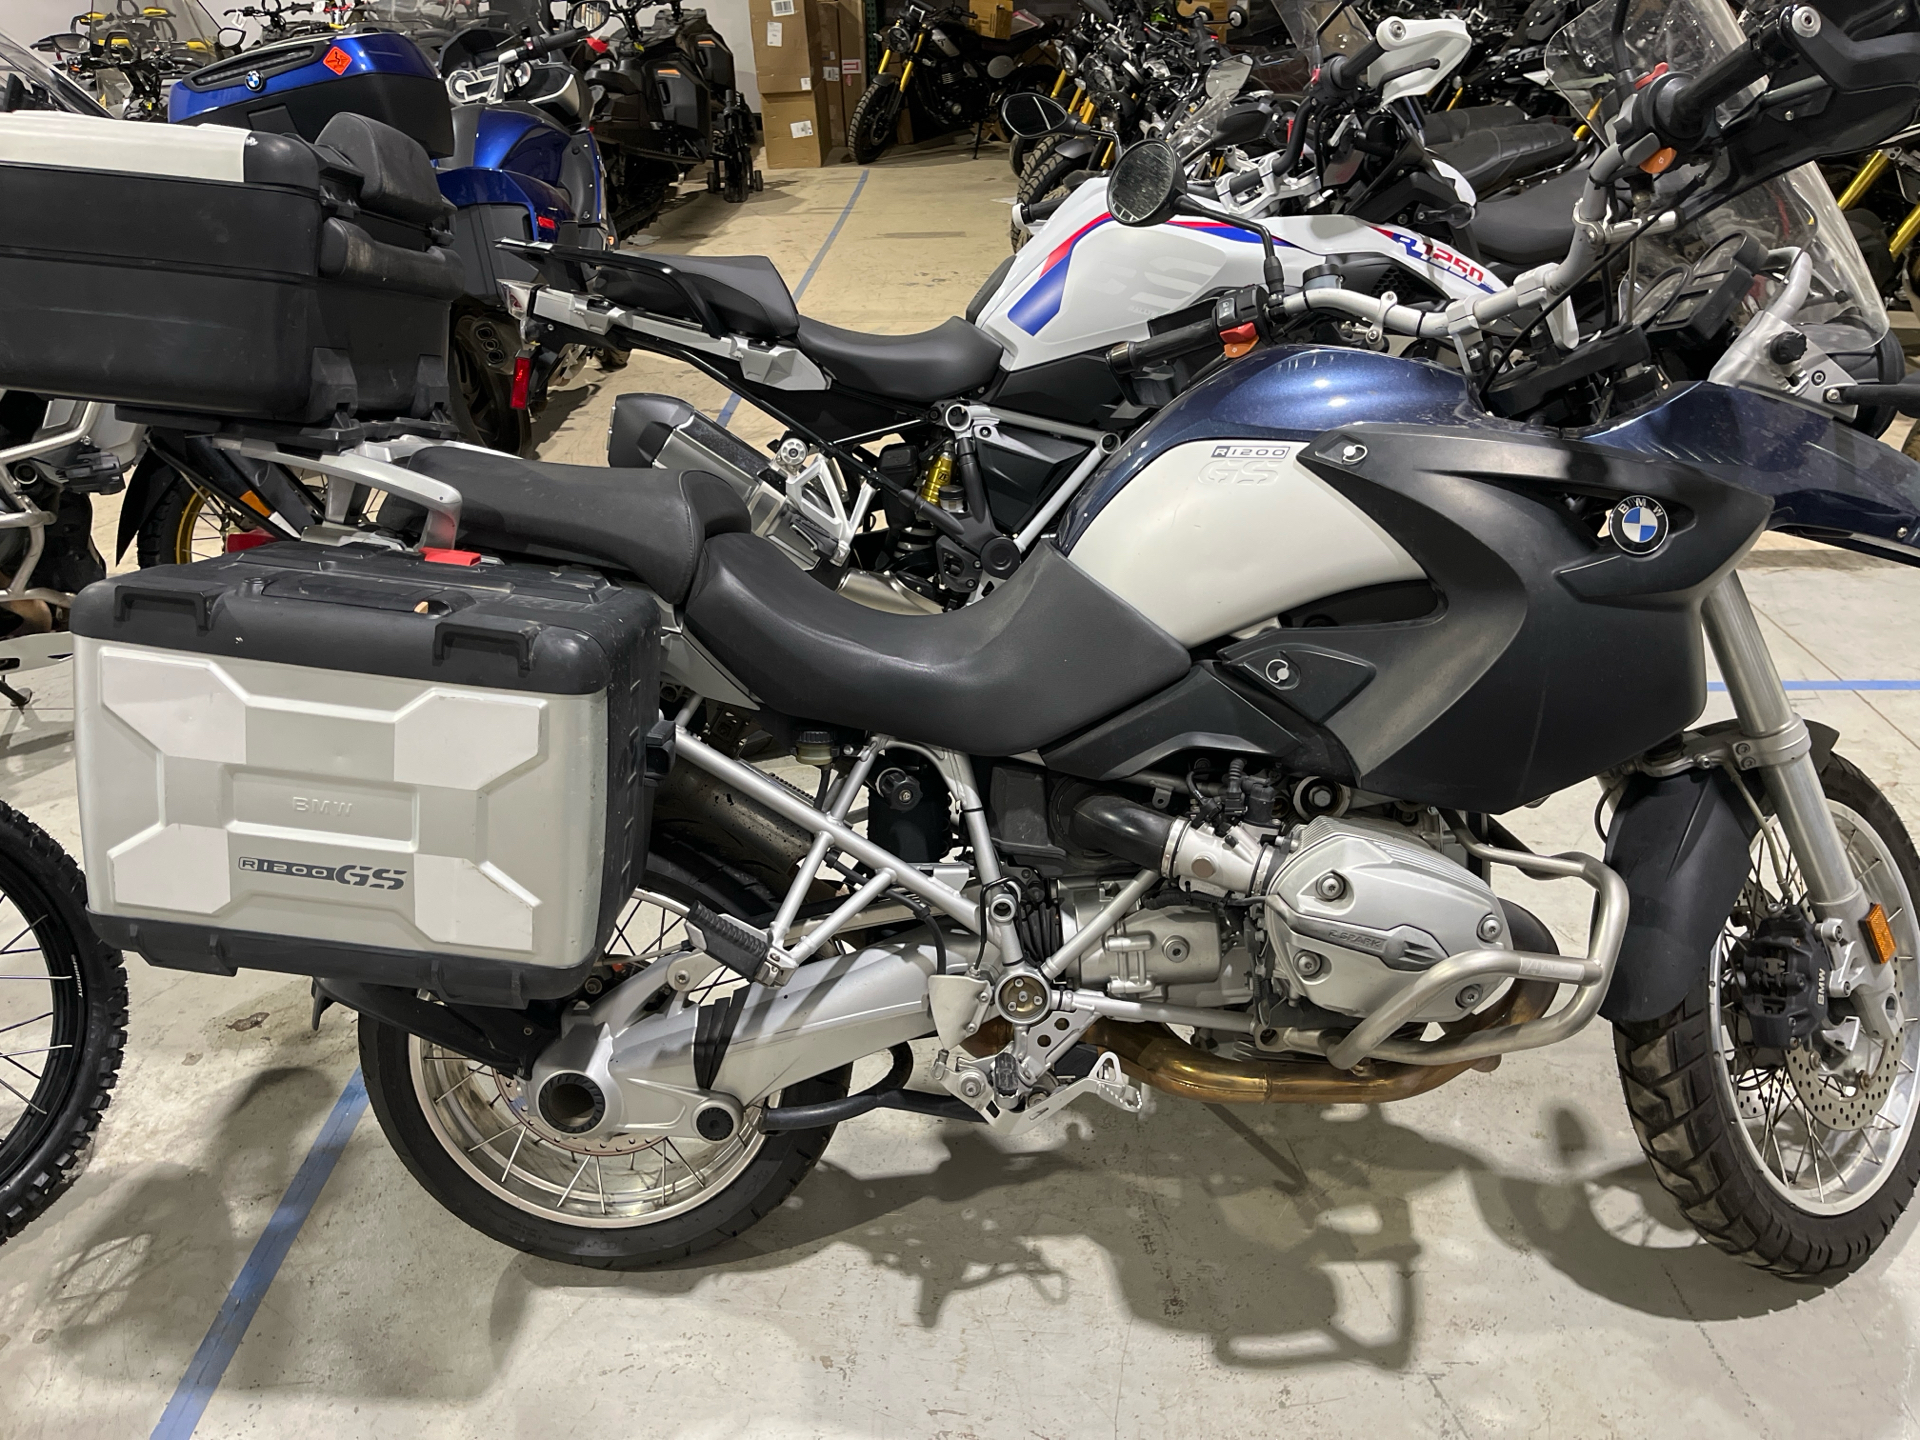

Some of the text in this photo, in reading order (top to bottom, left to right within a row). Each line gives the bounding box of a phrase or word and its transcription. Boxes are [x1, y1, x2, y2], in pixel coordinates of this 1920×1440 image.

[1212, 447, 1288, 458] R1200
[1198, 460, 1282, 486] GS
[1617, 497, 1664, 517] BMW
[293, 796, 352, 817] BMW
[1817, 967, 1826, 1006] BMW
